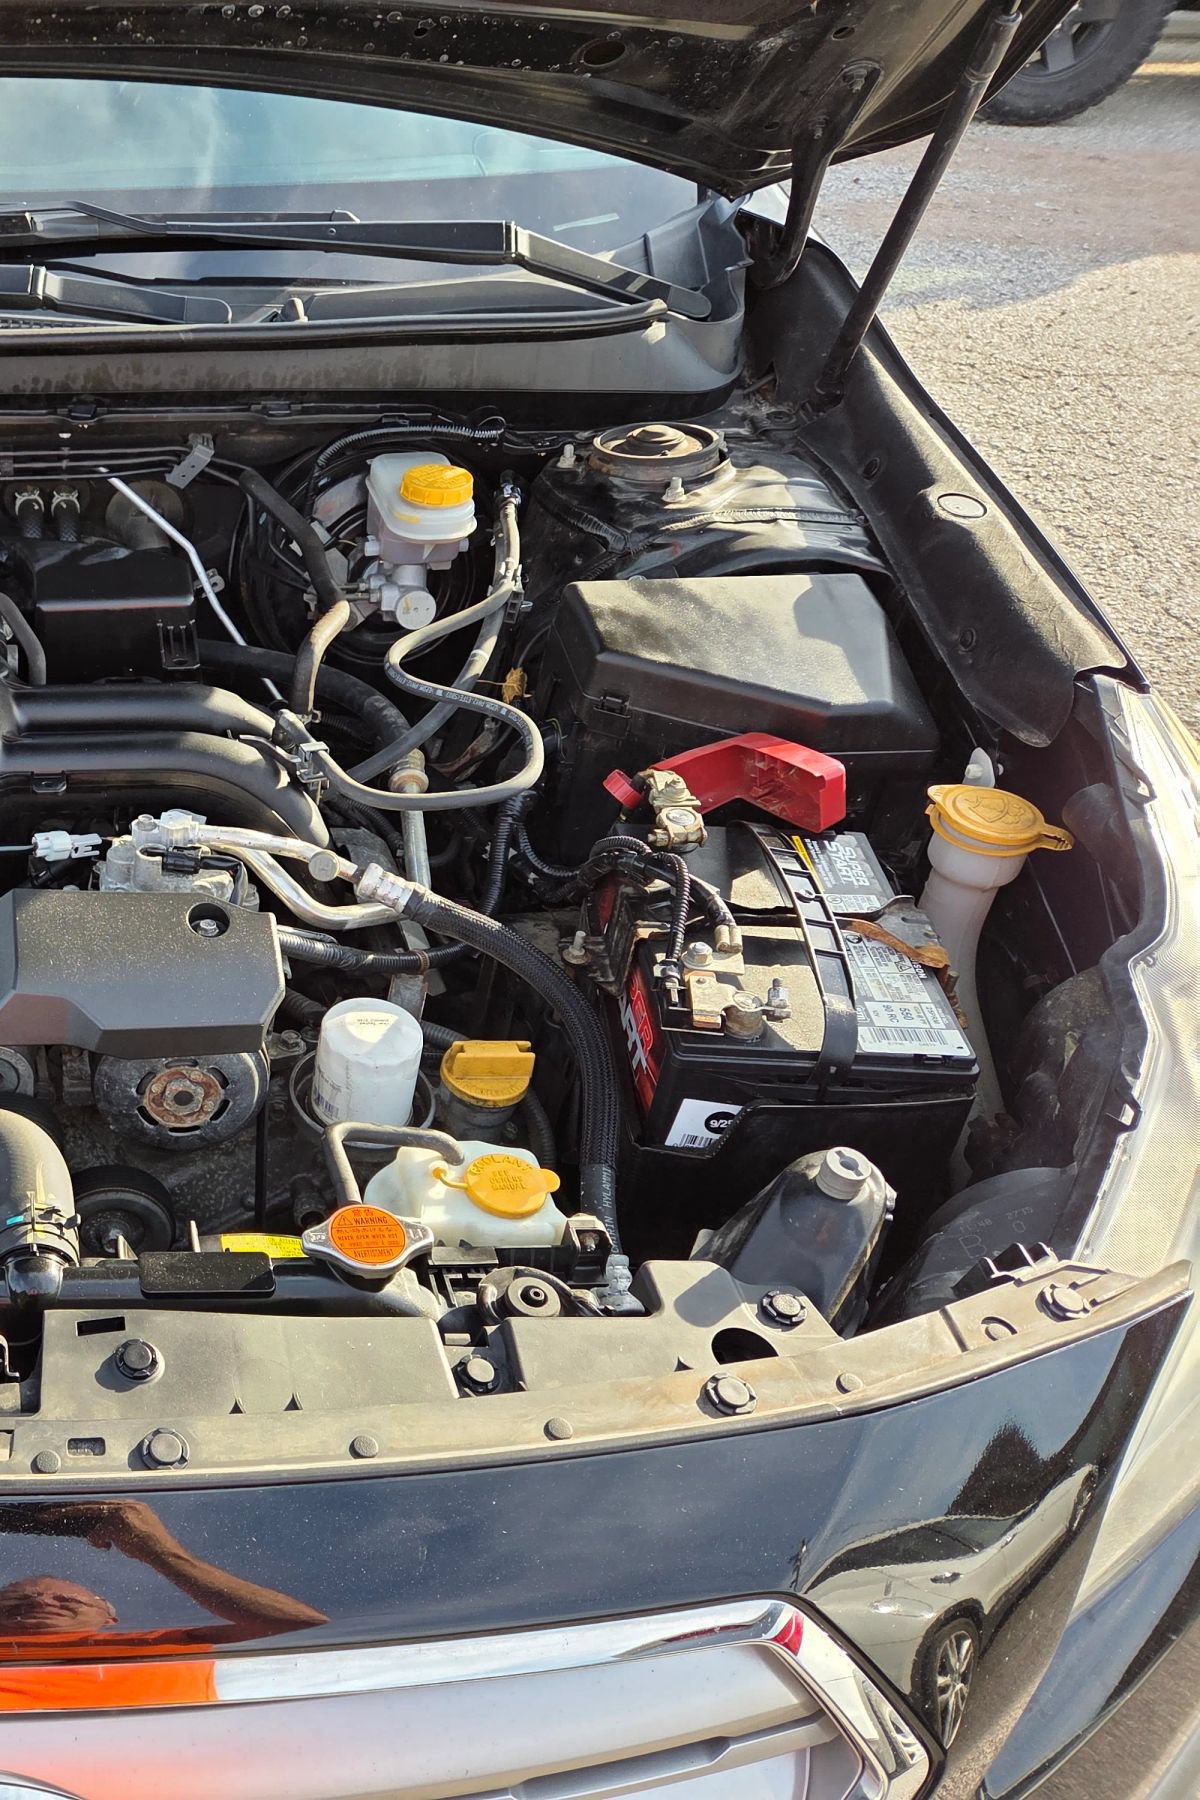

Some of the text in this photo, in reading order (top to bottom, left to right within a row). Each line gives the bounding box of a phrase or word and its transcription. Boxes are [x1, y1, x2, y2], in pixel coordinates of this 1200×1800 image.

[823, 840, 858, 886] START
[844, 846, 870, 886] SUPER
[911, 958, 928, 979] ISON
[618, 991, 647, 1074] ART
[353, 1216, 389, 1226] WARNING
